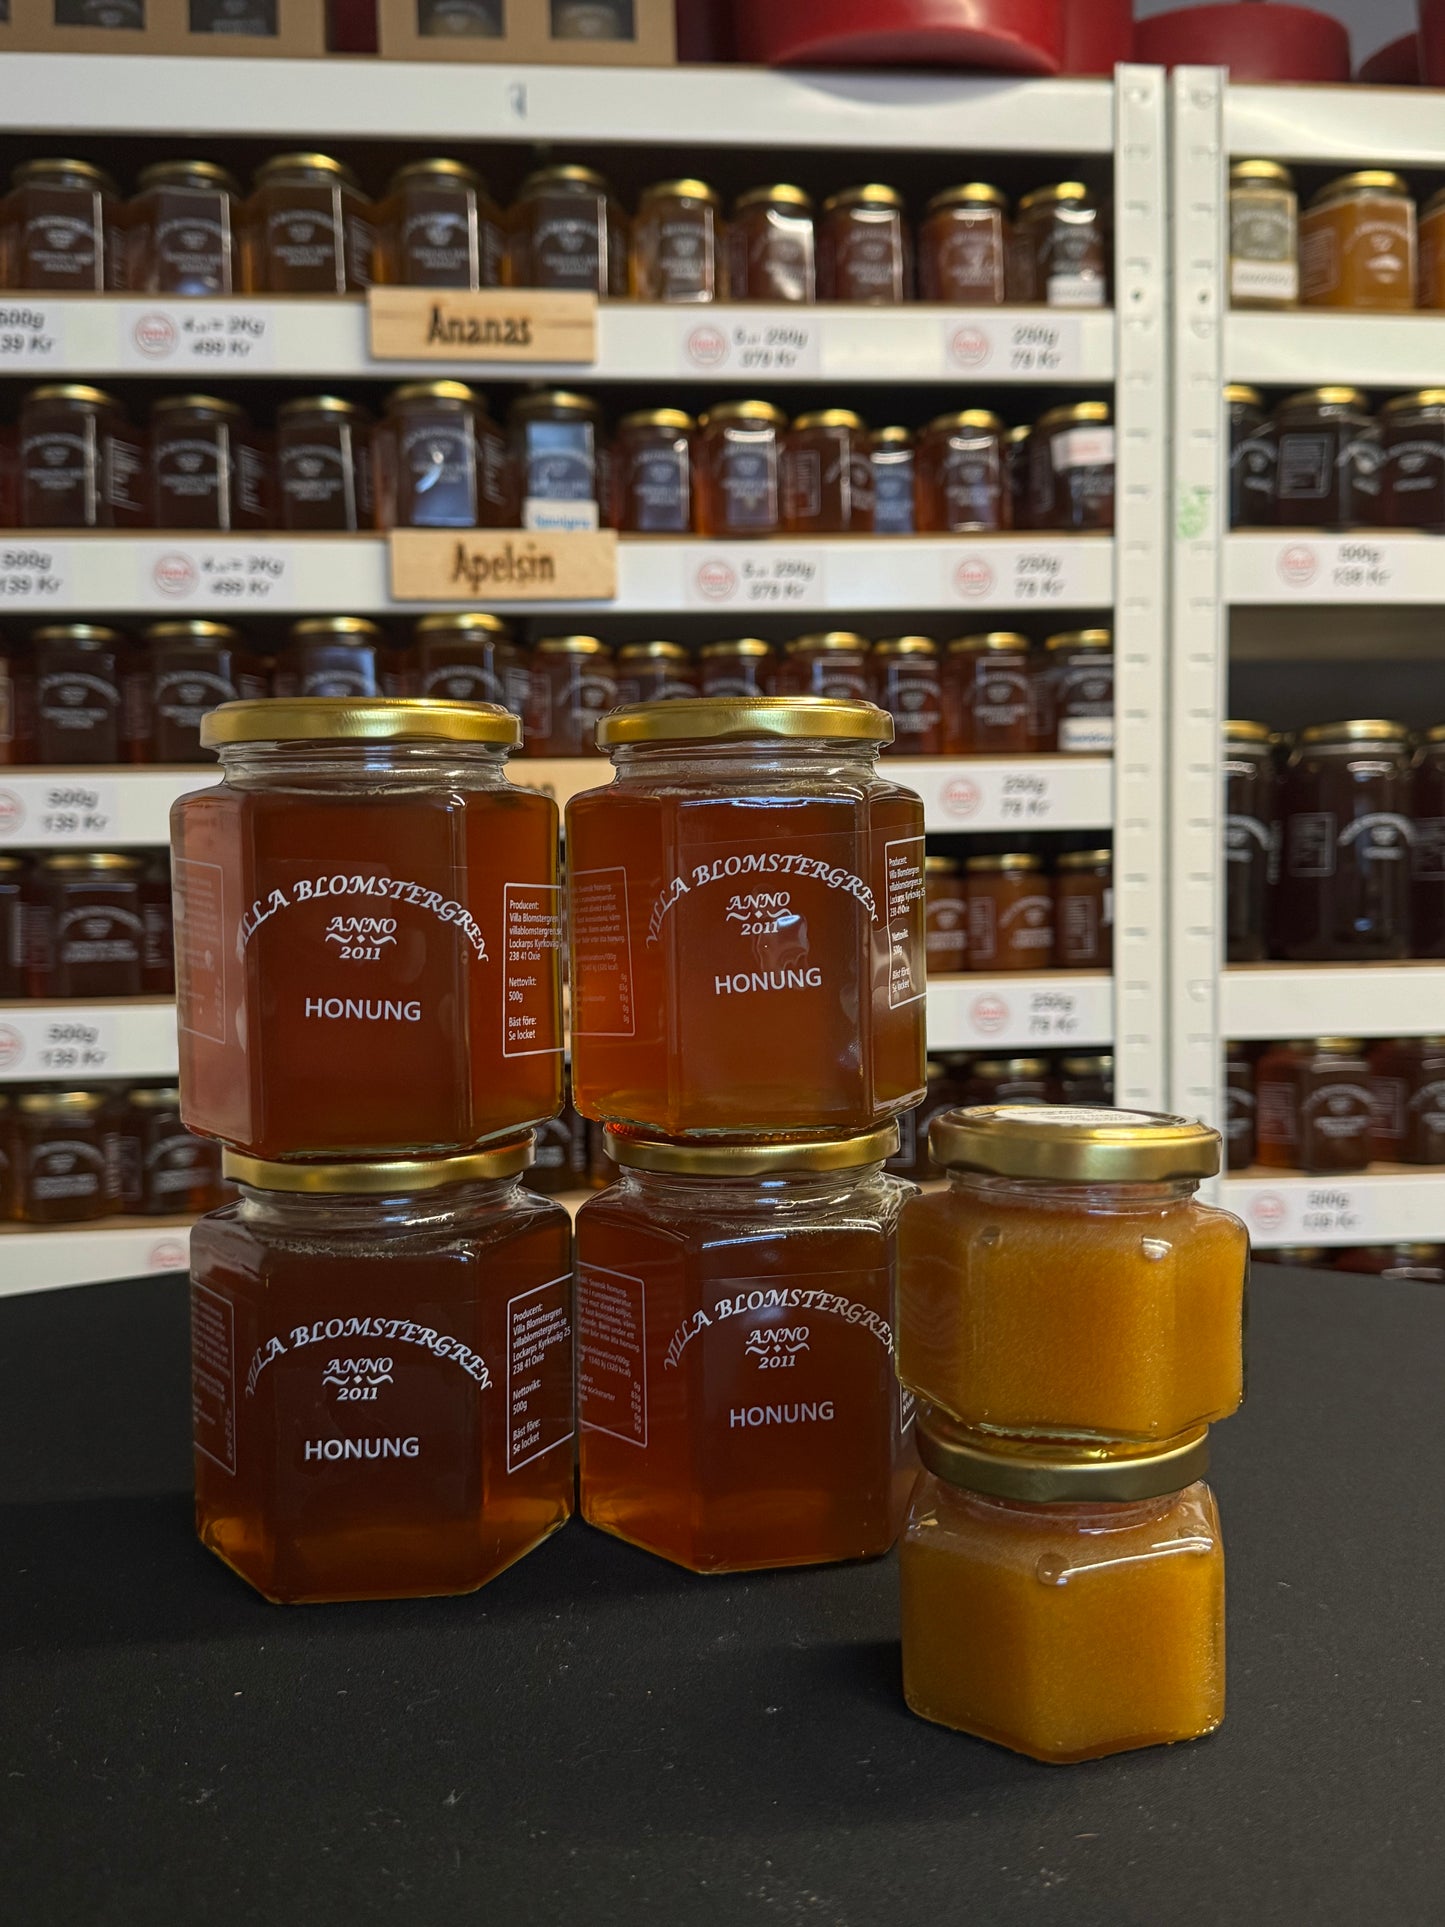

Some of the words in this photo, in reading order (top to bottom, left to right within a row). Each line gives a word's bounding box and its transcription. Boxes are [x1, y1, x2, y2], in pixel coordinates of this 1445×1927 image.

[427, 303, 532, 346] Ananas
[451, 540, 555, 597] Apelsin
[509, 899, 540, 910] Producent:
[646, 876, 691, 949] VILLA
[692, 853, 879, 923] BLOMSTERGREN
[725, 891, 791, 911] ANNO
[293, 875, 489, 963] BLOMSTERGREN
[326, 916, 397, 934] ANNO
[509, 912, 522, 922] Villa
[740, 921, 779, 936] 2011
[338, 946, 382, 961] 2011
[509, 938, 534, 950] Lockarps
[509, 951, 520, 961] 238
[520, 951, 527, 961] 41
[508, 976, 537, 987] Nettovikt:
[715, 967, 822, 995] HONUNG
[508, 991, 524, 1003] 500g
[305, 997, 421, 1022] HONUNG
[508, 1016, 521, 1027] Bäst
[522, 1015, 537, 1026] före:
[508, 1030, 516, 1040] Se
[517, 1029, 536, 1040] locket
[513, 1303, 543, 1324] Producent:
[513, 1323, 525, 1336] Villa
[526, 1307, 563, 1330] Blomstergren
[513, 1317, 567, 1349] villablomstergren.se
[663, 1309, 712, 1371] VILLA
[714, 1288, 895, 1355] BLOMSTERGREN
[745, 1326, 810, 1345] ANNO
[513, 1344, 538, 1362] Lockarps
[538, 1330, 564, 1351] Kyrkoväg
[564, 1325, 571, 1337] 25
[246, 1336, 287, 1399] VILLA
[289, 1317, 493, 1391] BLOMSTERGREN
[323, 1357, 393, 1374] ANNO
[513, 1362, 523, 1375] 238
[524, 1358, 531, 1368] 41
[531, 1351, 545, 1365] Oxie
[758, 1355, 796, 1369] 2011
[336, 1387, 378, 1401] 2011
[512, 1379, 541, 1401] Nettovikt:
[513, 1400, 528, 1415] 500g
[730, 1401, 835, 1428] HONUNG
[513, 1425, 526, 1441] Bäst
[526, 1418, 541, 1432] före:
[305, 1437, 420, 1461] HONUNG
[513, 1443, 521, 1455] Se
[521, 1431, 540, 1449] locket
